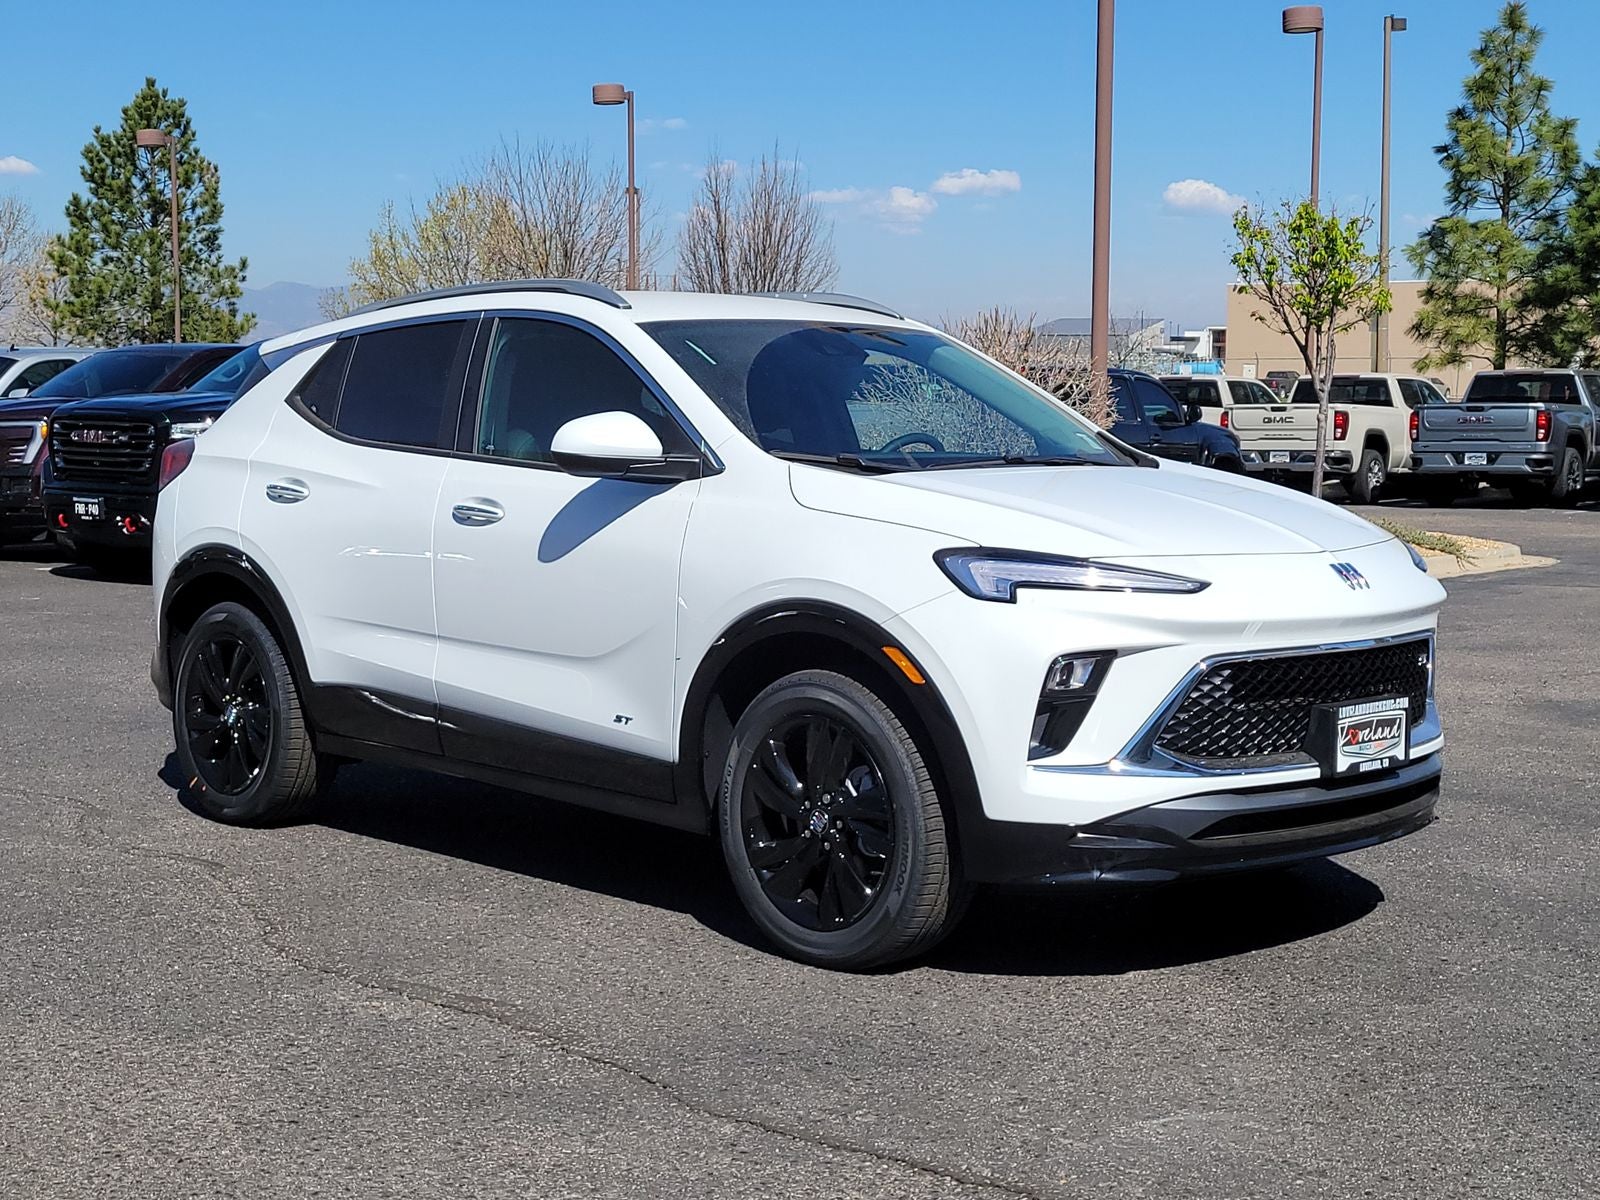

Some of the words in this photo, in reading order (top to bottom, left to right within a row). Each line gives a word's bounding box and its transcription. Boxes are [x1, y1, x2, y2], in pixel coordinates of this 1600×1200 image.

[1262, 416, 1295, 424] GMC
[1456, 415, 1495, 425] GMC
[70, 429, 118, 444] GMC
[612, 714, 634, 726] ST
